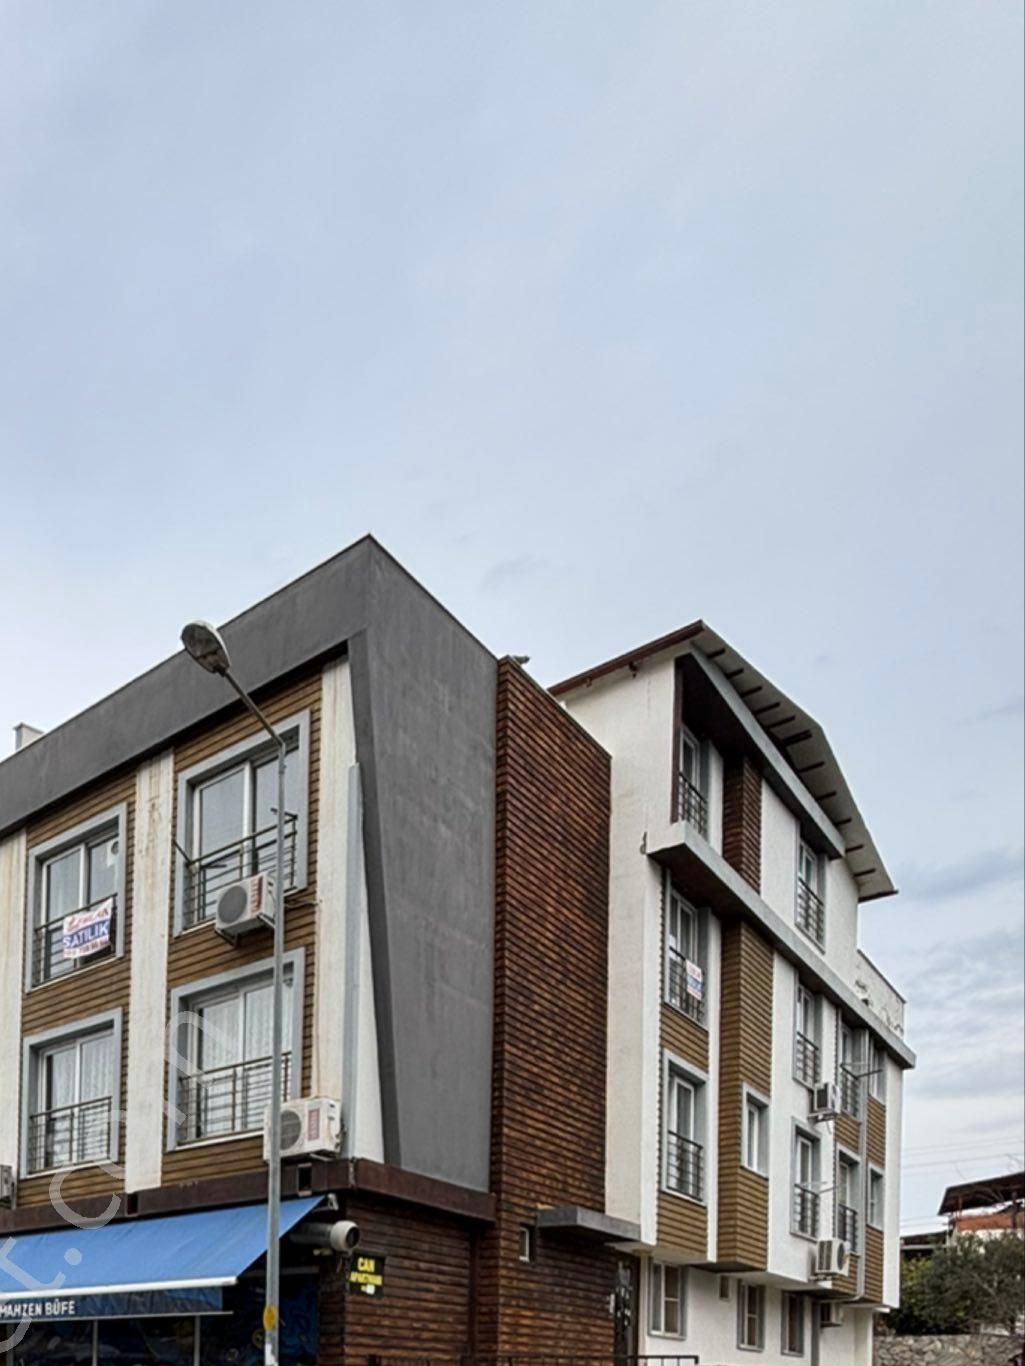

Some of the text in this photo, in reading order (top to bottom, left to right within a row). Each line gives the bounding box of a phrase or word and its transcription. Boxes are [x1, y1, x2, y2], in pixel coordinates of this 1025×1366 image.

[64, 922, 108, 948] SATILIK
[357, 1257, 375, 1272] CAN
[45, 1298, 76, 1315] BÜFE
